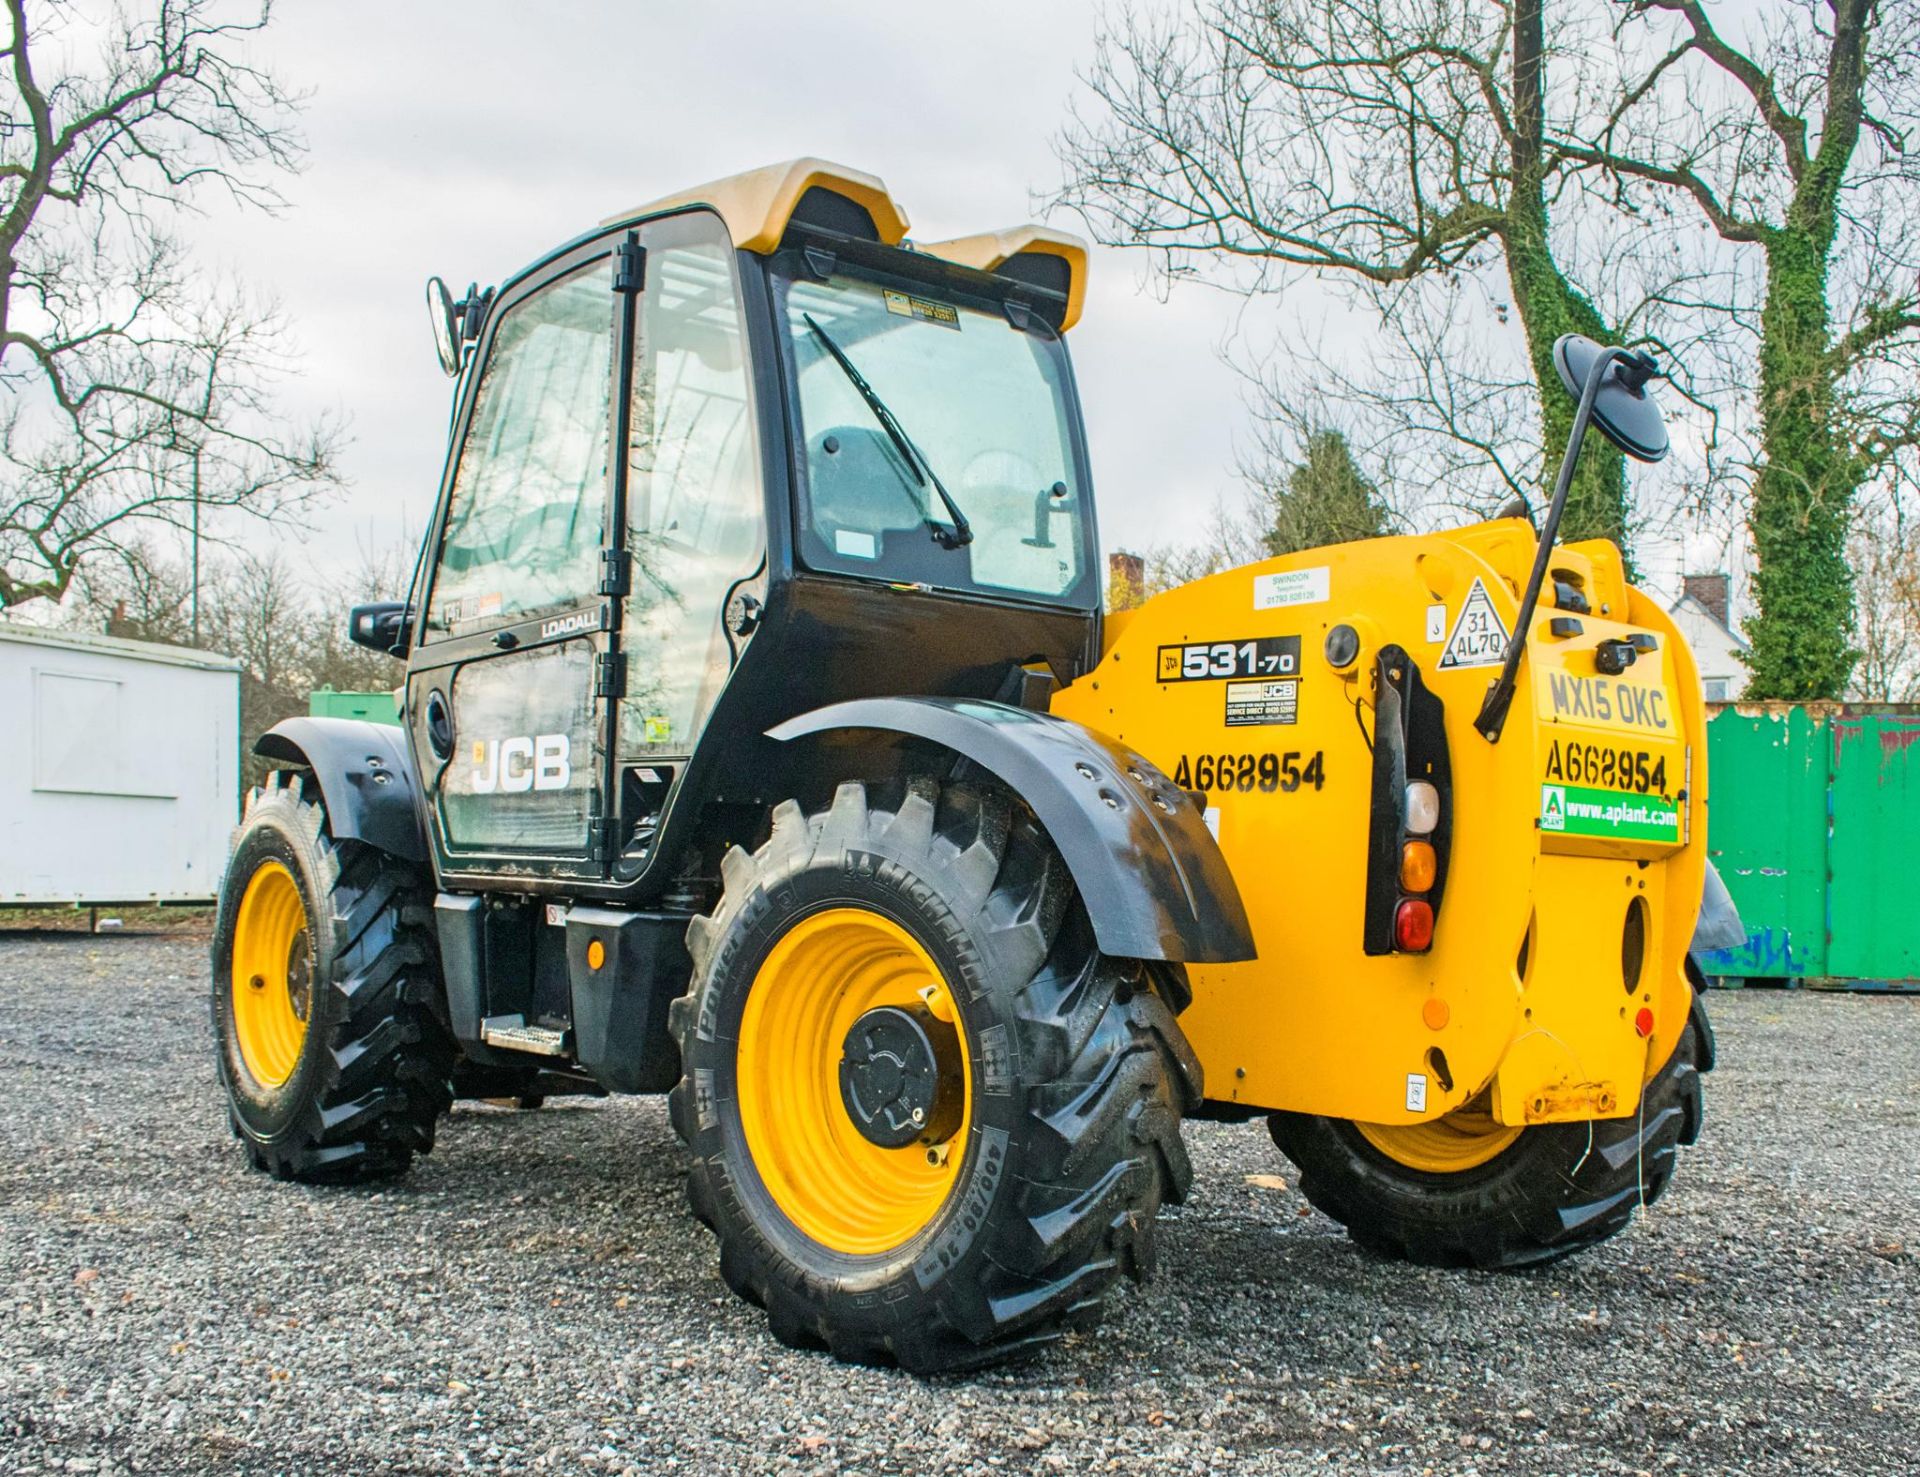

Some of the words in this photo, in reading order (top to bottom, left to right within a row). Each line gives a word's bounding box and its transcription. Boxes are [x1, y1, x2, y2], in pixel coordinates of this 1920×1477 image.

[1272, 573, 1309, 585] SWINDON
[541, 612, 599, 639] LOADALL
[1468, 612, 1488, 633] 31
[1182, 642, 1294, 678] 531-70
[1457, 633, 1500, 656] AL7Q
[1264, 684, 1293, 698] JCB
[1550, 672, 1611, 720] MX15
[1616, 684, 1667, 728] OKC
[472, 734, 570, 794] JCB
[1174, 751, 1325, 792] A668954
[1545, 739, 1667, 796] A668954
[1566, 801, 1678, 827] www.aplant.com
[876, 858, 994, 1004] MICHELIN
[699, 936, 740, 1037] Power
